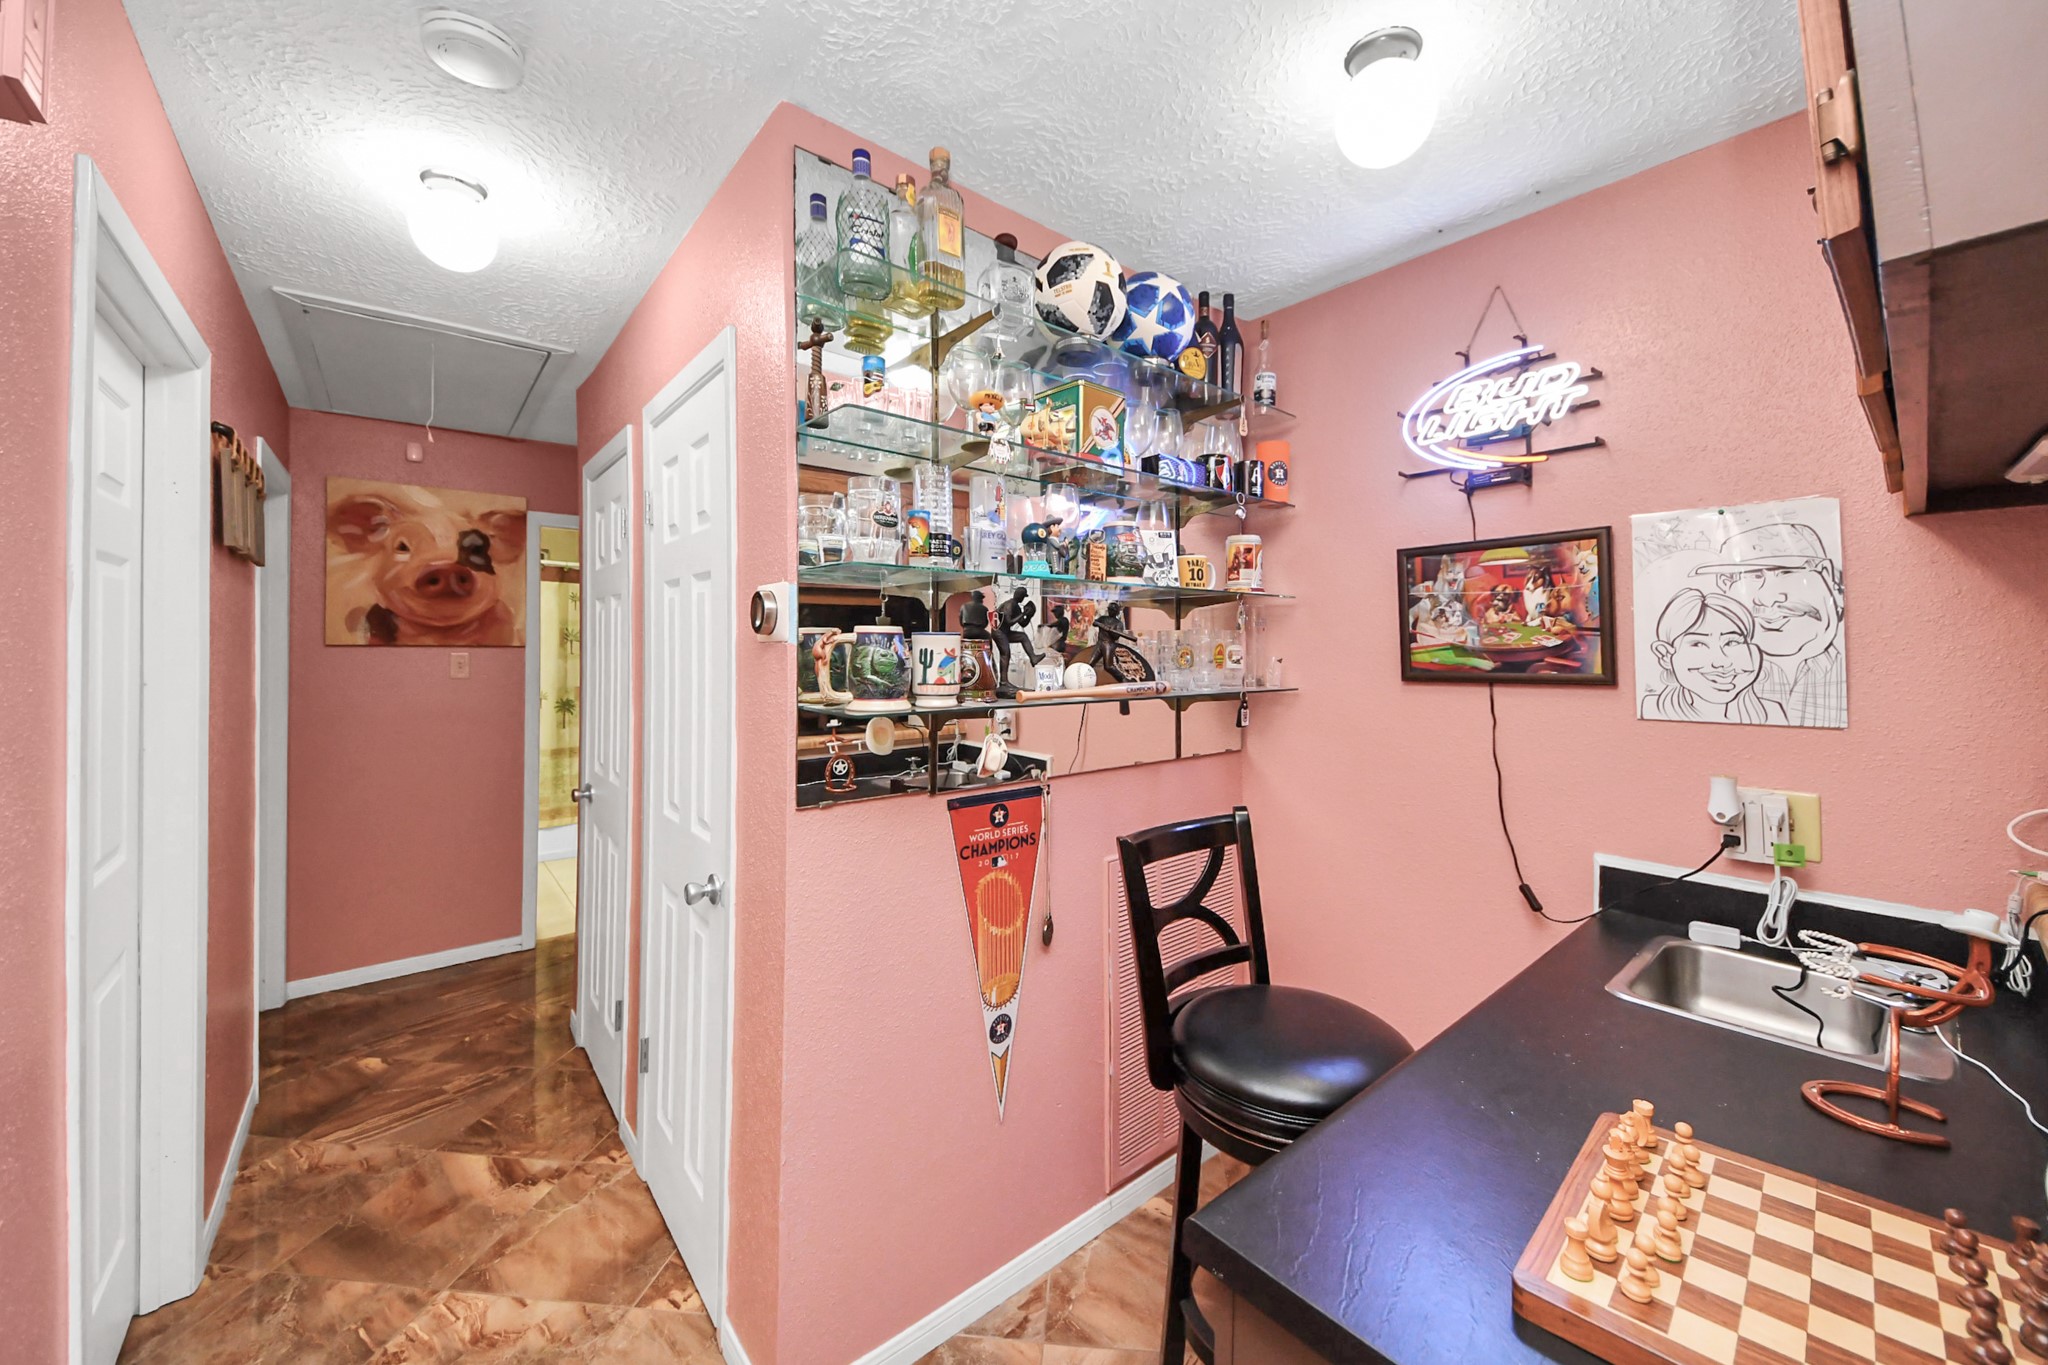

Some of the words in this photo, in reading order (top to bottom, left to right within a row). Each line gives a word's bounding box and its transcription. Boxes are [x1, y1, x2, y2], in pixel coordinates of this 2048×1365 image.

[1443, 362, 1581, 414] BUD
[1417, 384, 1589, 446] LIGHT
[1187, 558, 1205, 568] PARIS
[1188, 568, 1204, 581] 10
[1126, 686, 1155, 694] CHAMPIONS
[969, 830, 1001, 842] WORLD
[1002, 824, 1029, 837] SERIES
[960, 832, 1037, 860] CHAMPIONS
